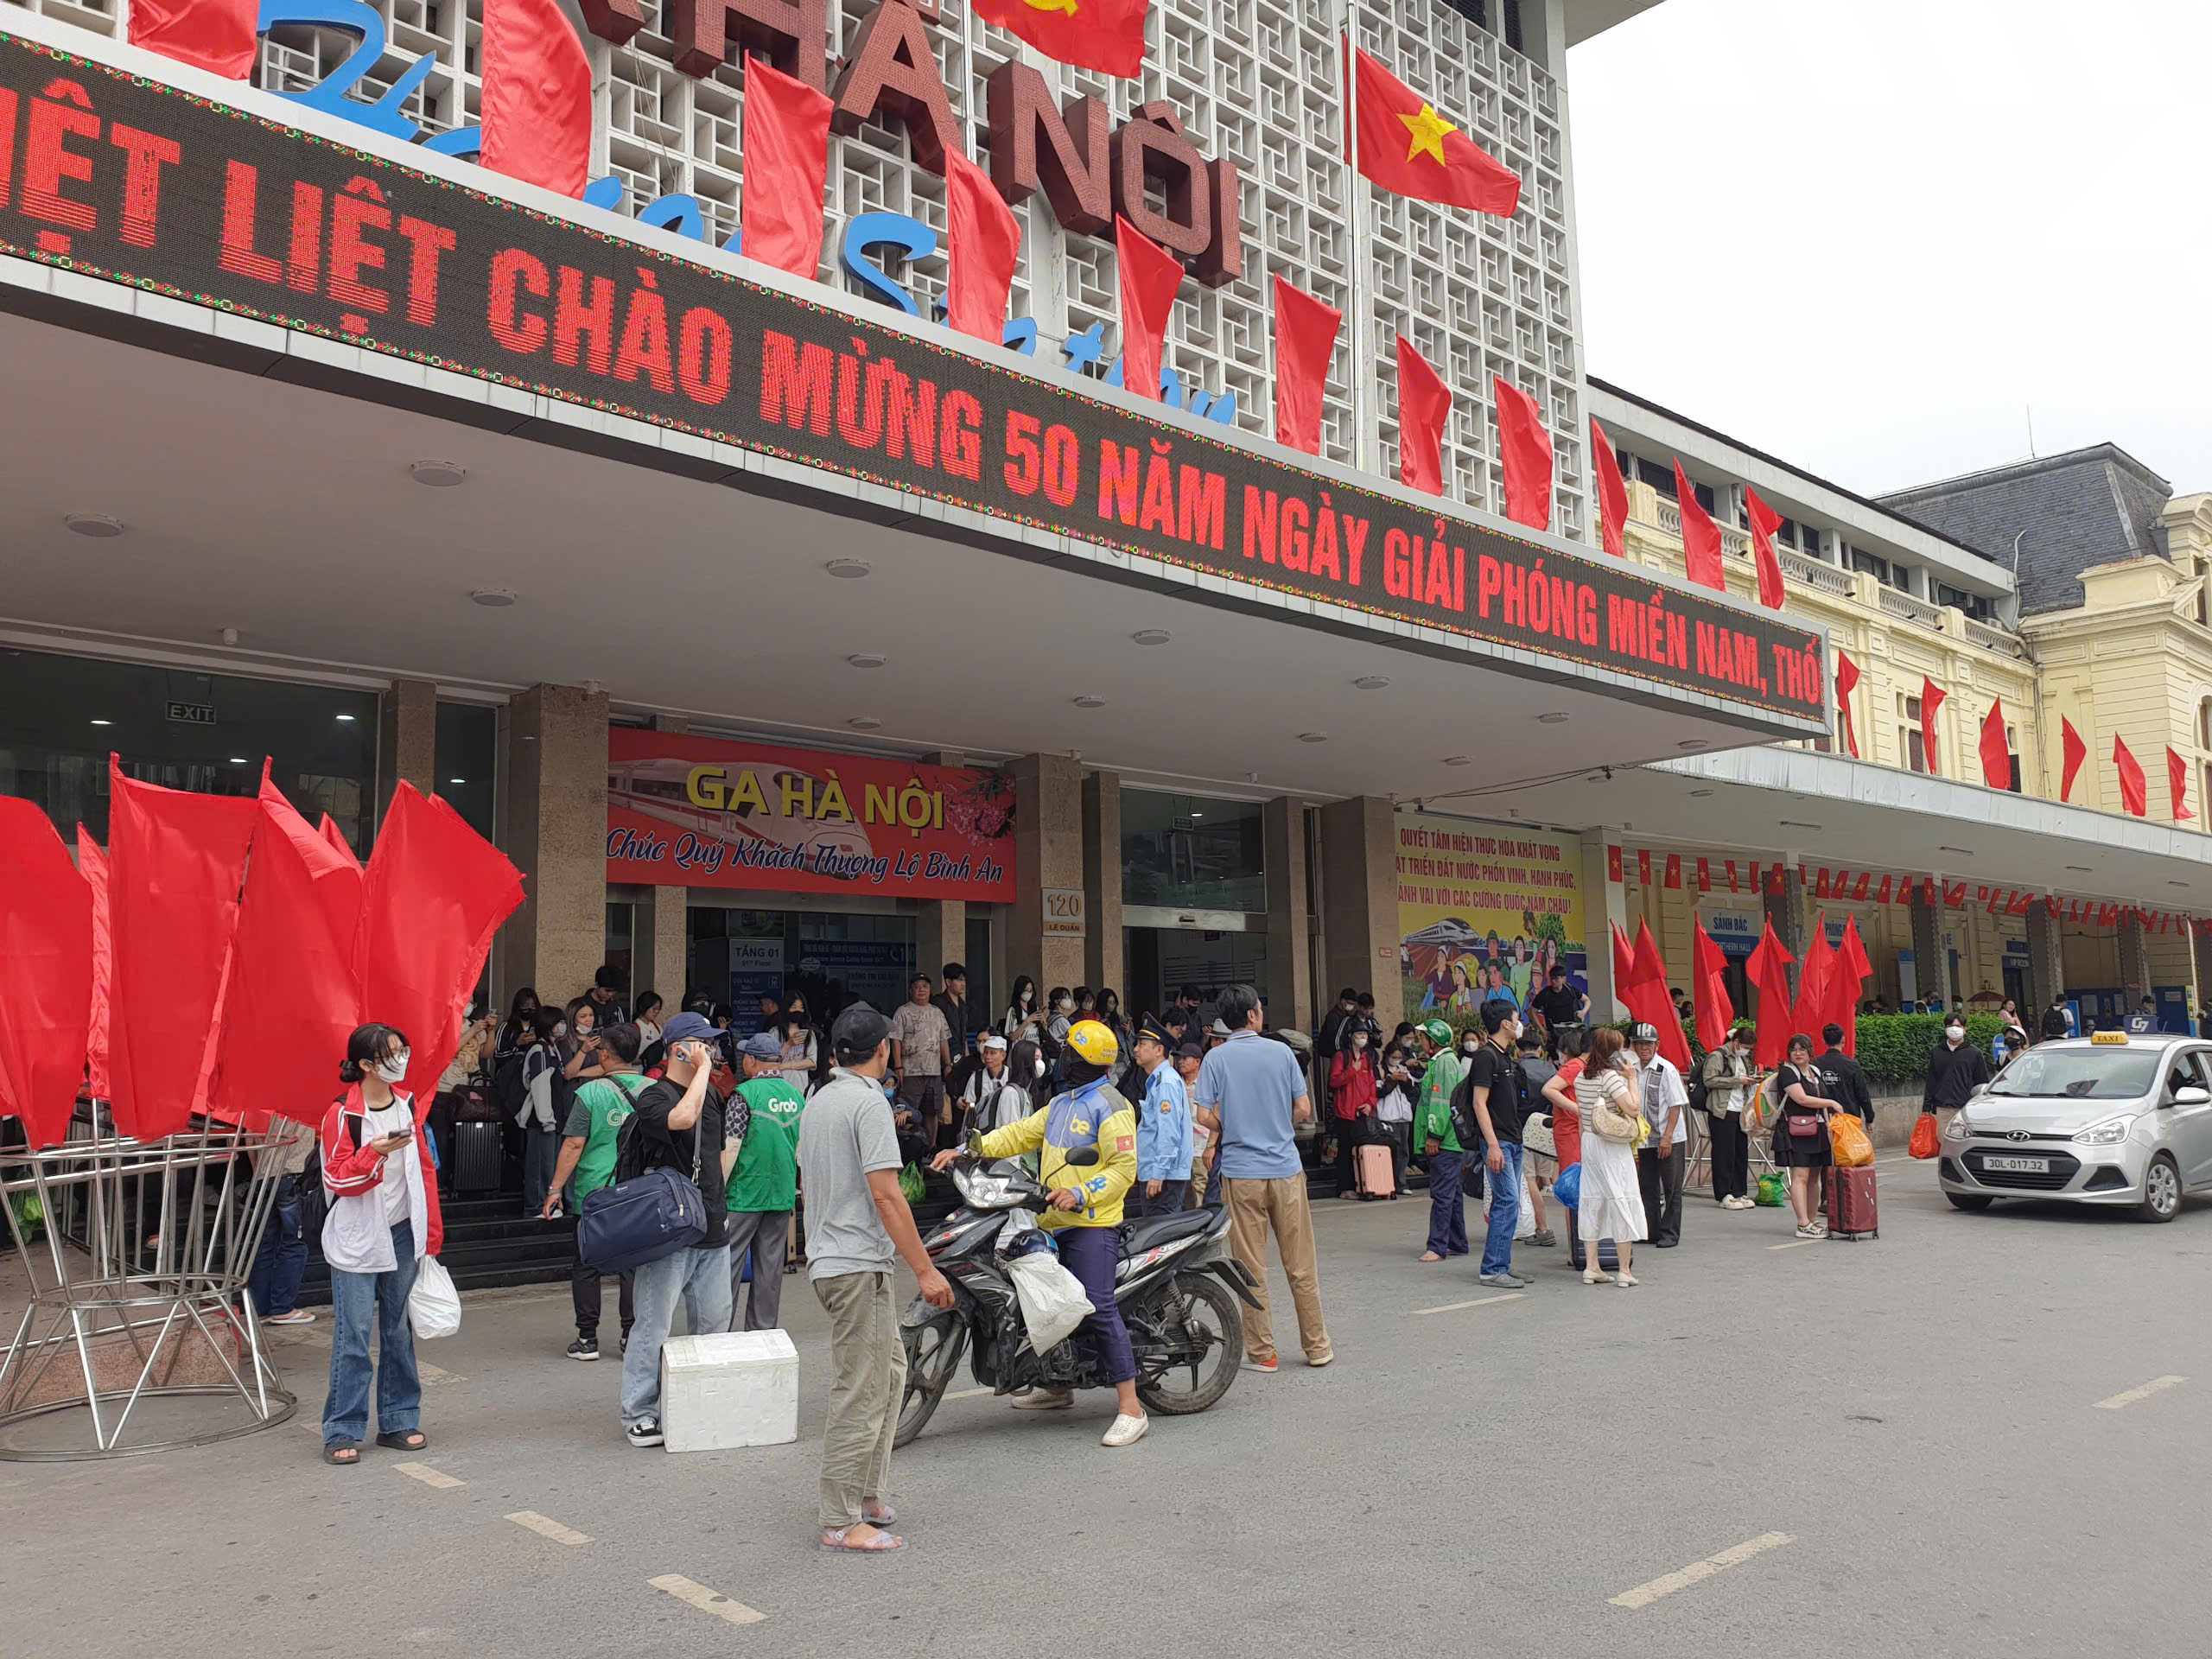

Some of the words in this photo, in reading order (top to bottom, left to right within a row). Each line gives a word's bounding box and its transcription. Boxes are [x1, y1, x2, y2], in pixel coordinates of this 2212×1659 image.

[218, 159, 456, 333] LIỆT
[488, 248, 733, 404] CHÀO
[759, 329, 982, 481] MỪNG
[1003, 408, 1080, 507] 50
[1098, 436, 1225, 551] NĂM
[1243, 485, 1370, 586] NGÀY
[1383, 515, 1465, 612] GIẢI
[1478, 554, 1598, 646] PHÓNG
[1608, 588, 1688, 671] MIỀN
[1695, 620, 1768, 698] NAM,
[1772, 637, 1826, 706] THỐ
[171, 704, 213, 721] EXIT
[687, 766, 770, 816] GA
[782, 768, 855, 823] HÀ
[865, 778, 944, 838] NỘI
[607, 828, 667, 861] Chúc
[675, 832, 725, 874] Quý
[731, 836, 805, 873] Khách
[814, 842, 889, 884] Thượng
[893, 849, 922, 882] Lộ
[925, 851, 970, 881] Bình
[974, 855, 1002, 884] An
[1401, 825, 1428, 848] QUYẾT
[1452, 831, 1472, 855] HIỆN
[1475, 836, 1496, 858] THỰC
[1498, 836, 1515, 857] HÓA
[1517, 839, 1537, 860] KHÁT
[1539, 843, 1560, 864] VỌNG
[1408, 852, 1434, 876] TRIỂN
[1437, 855, 1454, 878] ĐẤT
[1457, 860, 1480, 880] NƯỚC
[1531, 869, 1552, 889] HẠNH
[1554, 869, 1576, 891] PHÚC,
[1047, 893, 1082, 917] 120
[1420, 887, 1433, 905] VAI
[1436, 885, 1451, 906] VỚI
[1453, 887, 1471, 907] CÁC
[1472, 887, 1502, 909] CƯỜNG
[1503, 888, 1526, 912] QUỐC
[1713, 912, 1733, 931] SẢNH
[768, 948, 779, 957] 01
[1716, 941, 1738, 951] ORTHERN
[768, 1097, 798, 1113] Grab
[607, 1108, 631, 1127] Gr
[1070, 1113, 1090, 1136] be
[1989, 1159, 2044, 1170] 30L-017.32
